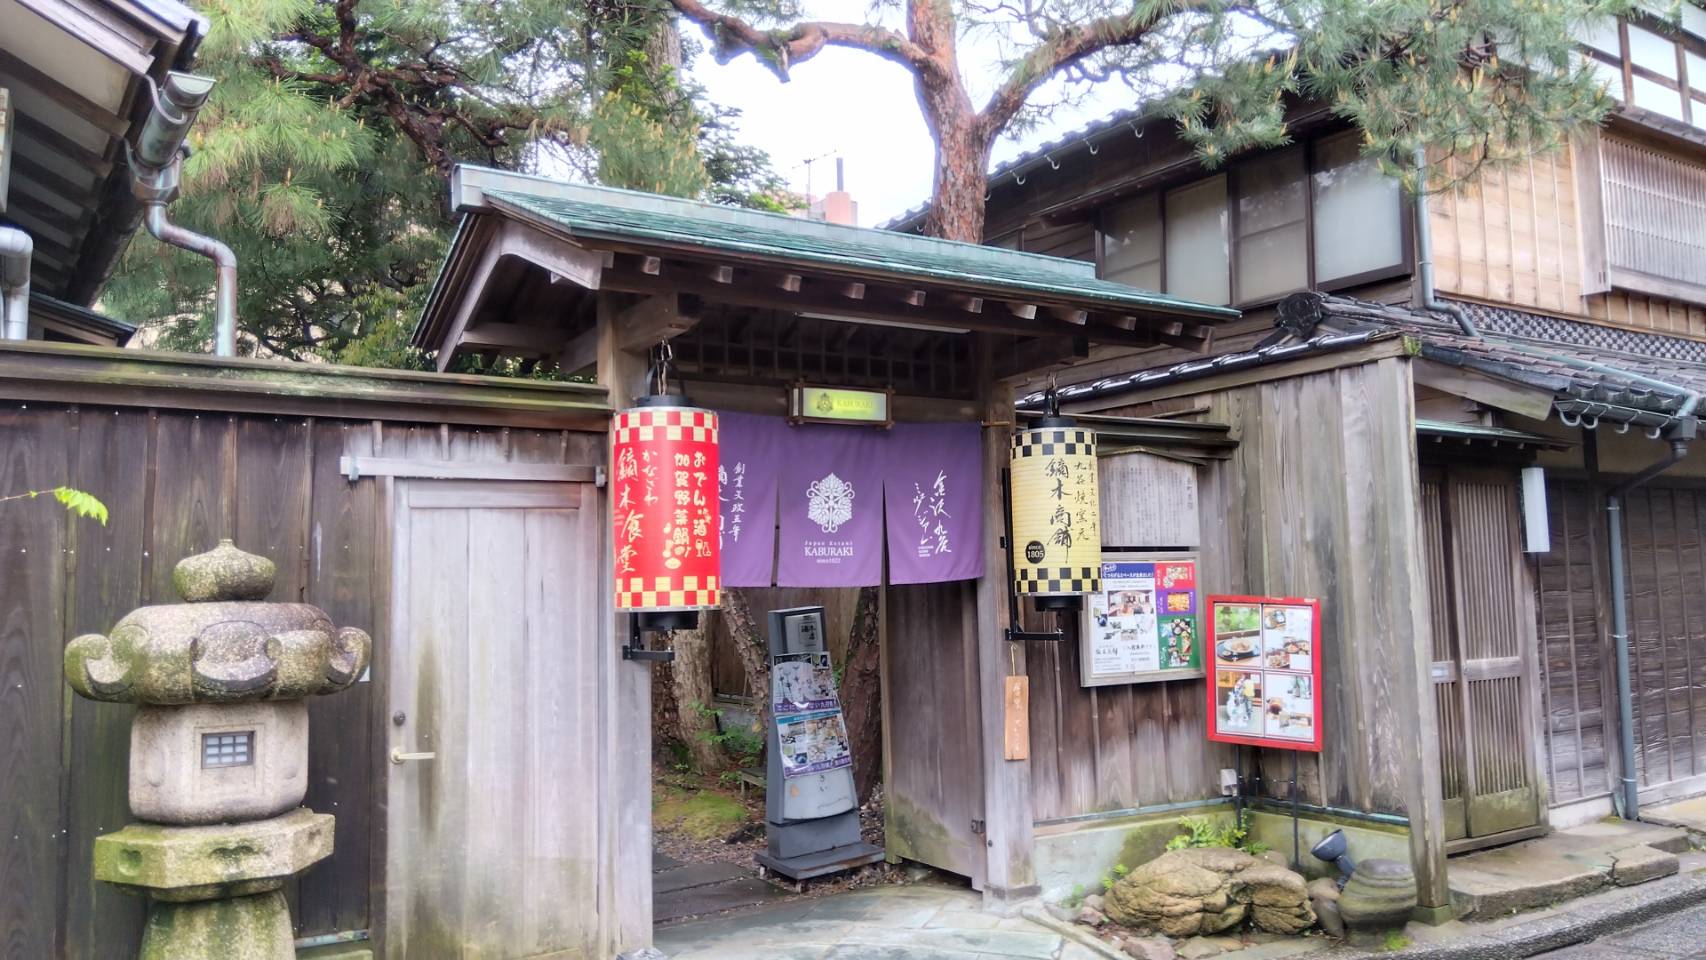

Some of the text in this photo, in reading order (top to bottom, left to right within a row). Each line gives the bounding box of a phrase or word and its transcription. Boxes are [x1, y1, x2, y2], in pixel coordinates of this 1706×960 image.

[673, 452, 691, 545] 加賀野菜鍋
[804, 546, 853, 556] KABURAKI
[1027, 550, 1044, 558] 1805
